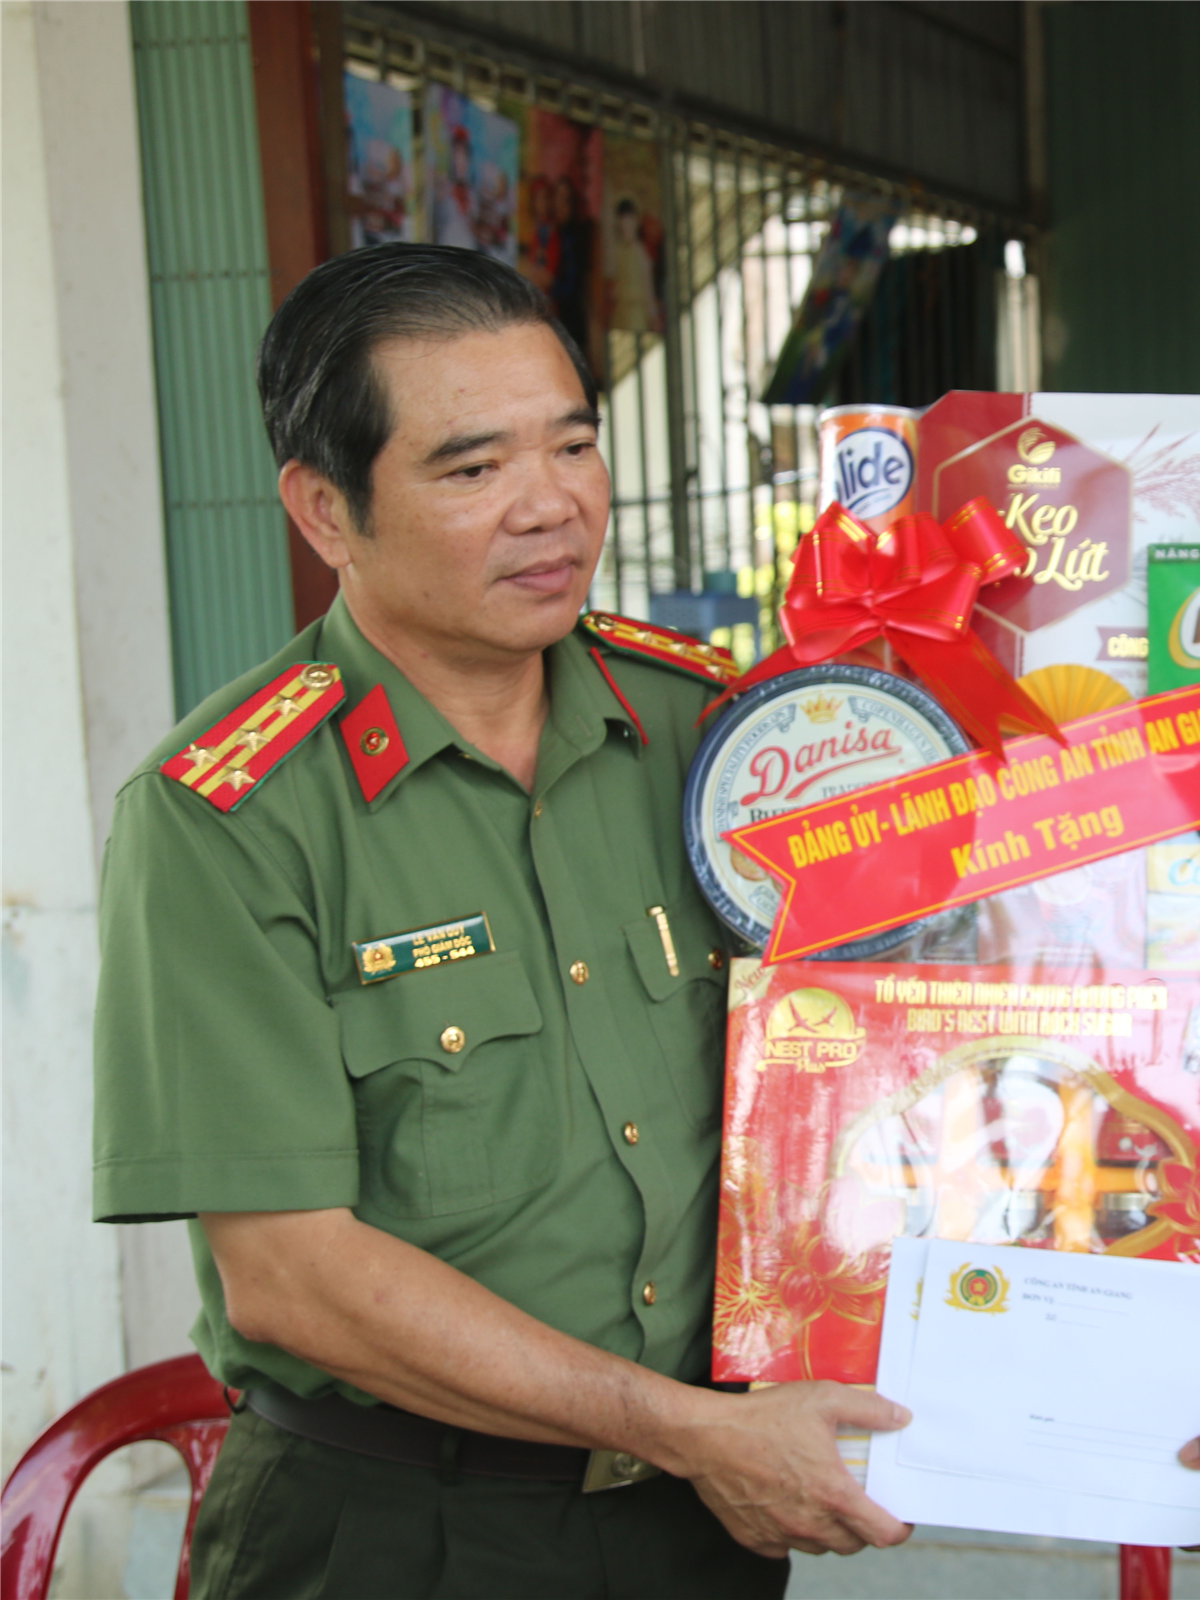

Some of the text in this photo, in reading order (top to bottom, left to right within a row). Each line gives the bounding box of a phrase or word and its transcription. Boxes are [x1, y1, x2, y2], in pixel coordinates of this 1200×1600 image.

[836, 441, 904, 501] lide
[740, 720, 902, 806] Danisa
[787, 819, 853, 868] ĐẢNG
[889, 788, 951, 836] LÃNH
[949, 773, 997, 818] ĐẠO
[998, 757, 1058, 800] CÔNG
[1061, 749, 1094, 788] AN
[1091, 724, 1145, 775] TỈNH
[1146, 716, 1181, 754] AN
[951, 804, 1125, 879] Kính Tặng
[765, 1041, 858, 1058] NEST PRO
